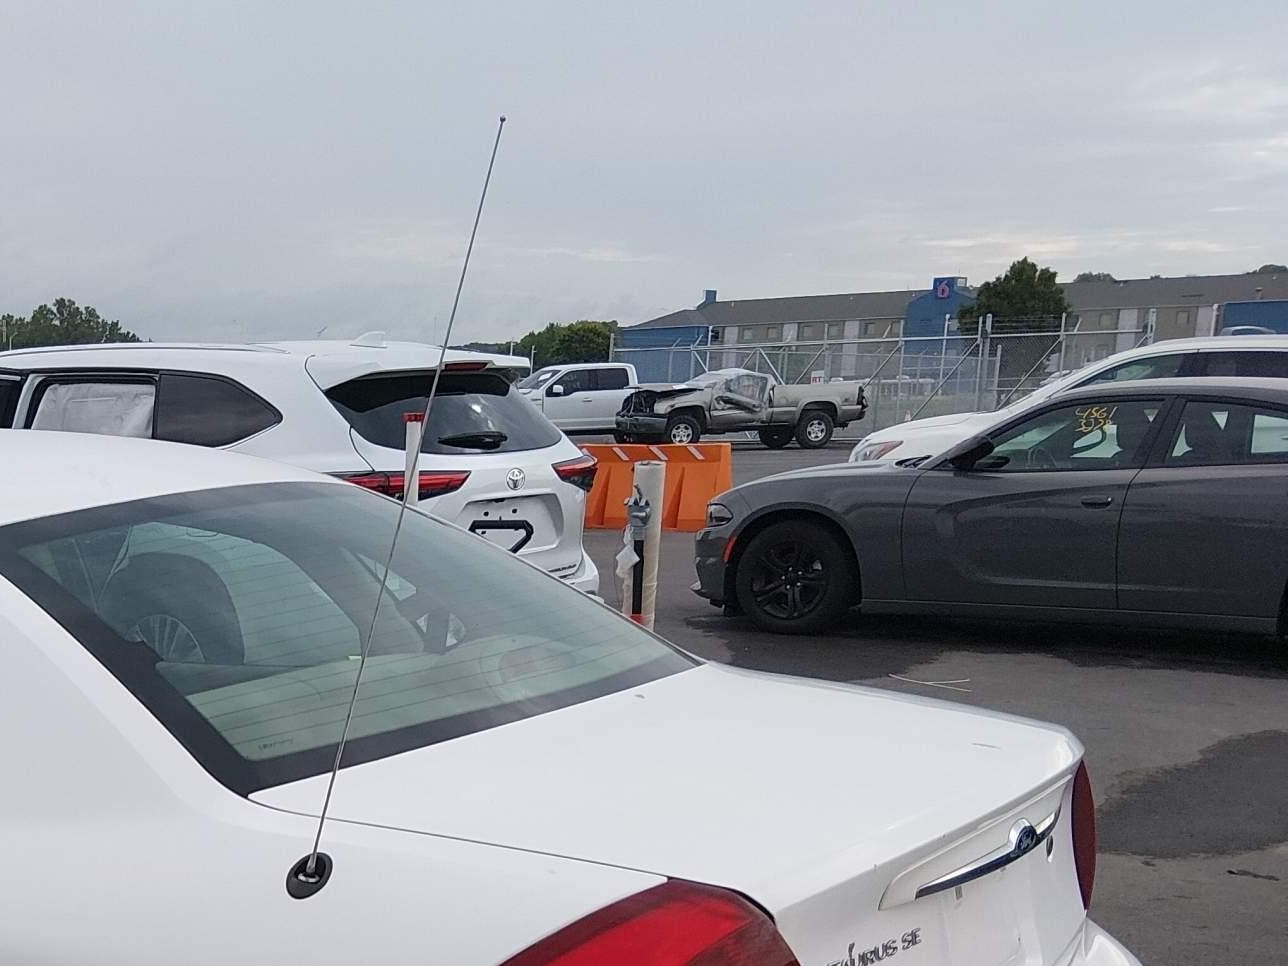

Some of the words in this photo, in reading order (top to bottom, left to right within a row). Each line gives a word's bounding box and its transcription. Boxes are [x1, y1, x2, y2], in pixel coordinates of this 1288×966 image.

[937, 280, 950, 298] 6
[1075, 406, 1118, 419] 4561
[901, 927, 922, 951] SE
